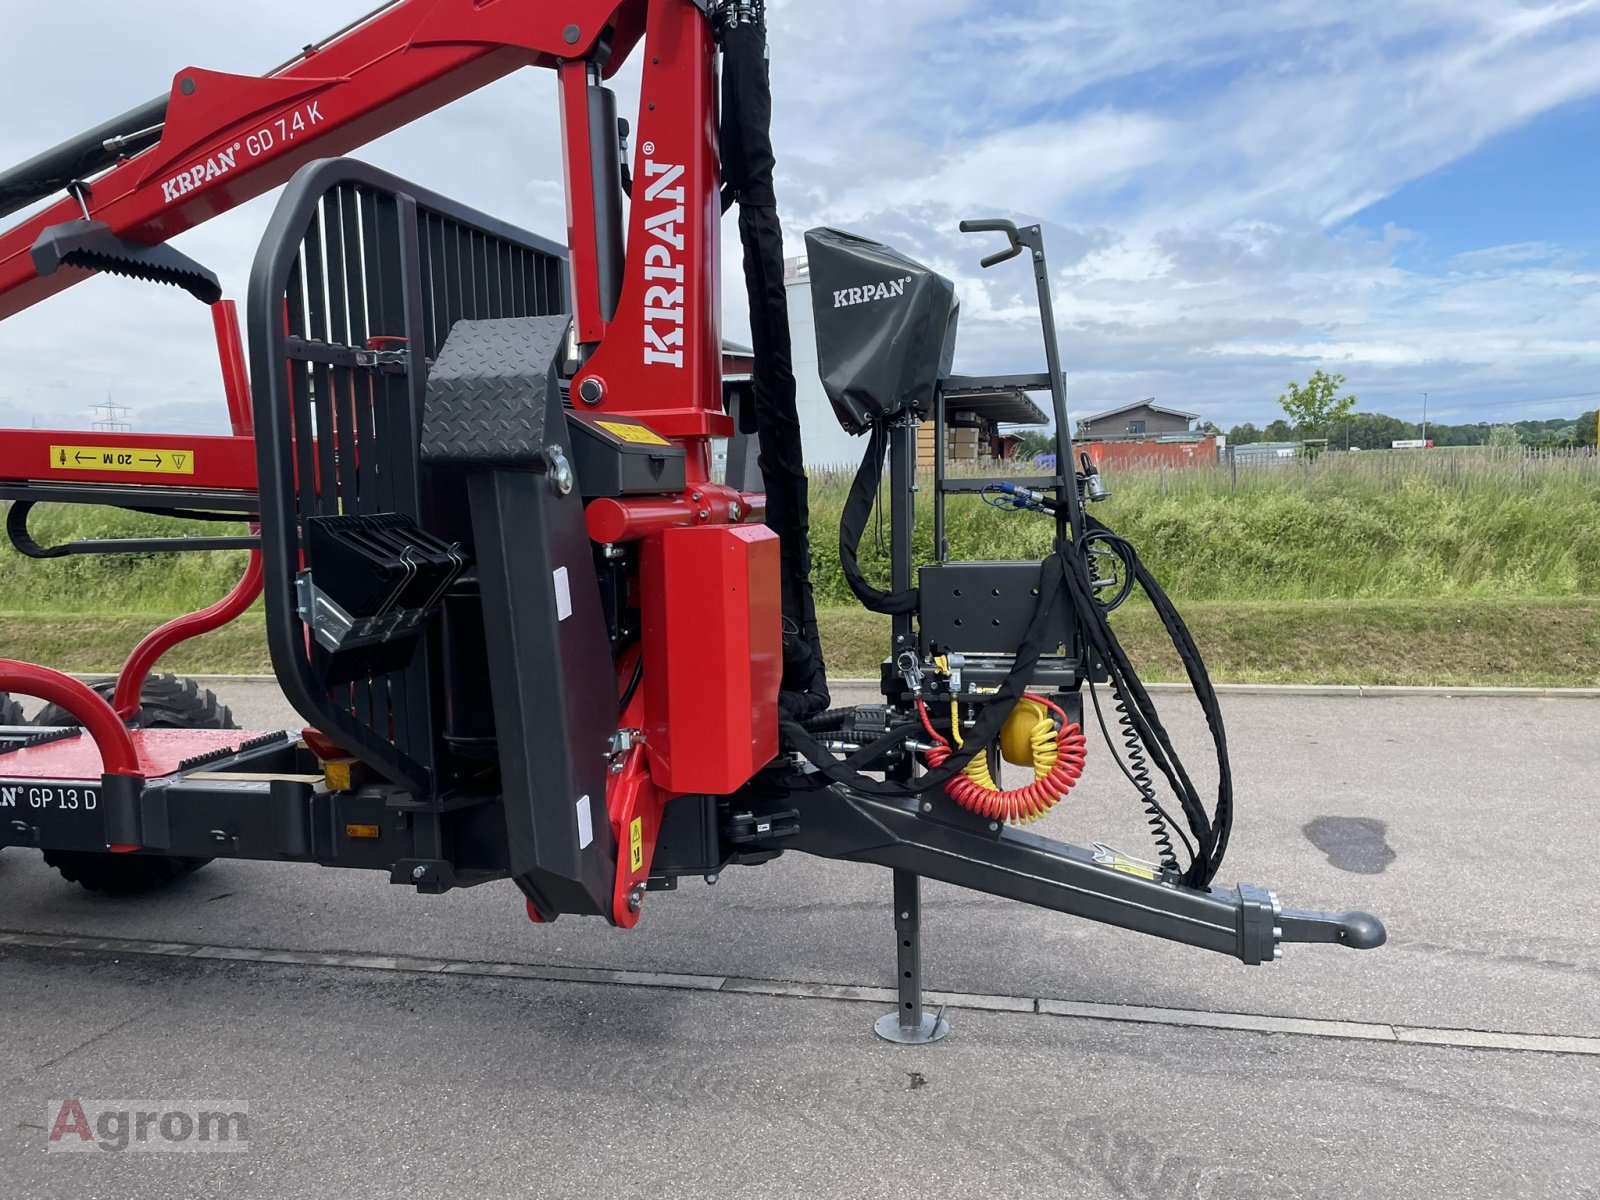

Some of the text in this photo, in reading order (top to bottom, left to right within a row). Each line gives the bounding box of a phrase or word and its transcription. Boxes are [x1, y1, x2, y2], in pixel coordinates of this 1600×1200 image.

[246, 129, 274, 157] GD
[274, 111, 305, 141] 7,4
[306, 100, 324, 125] K
[103, 453, 133, 465] 20 M
[29, 788, 53, 808] GP
[57, 789, 79, 809] 13
[84, 790, 97, 810] D
